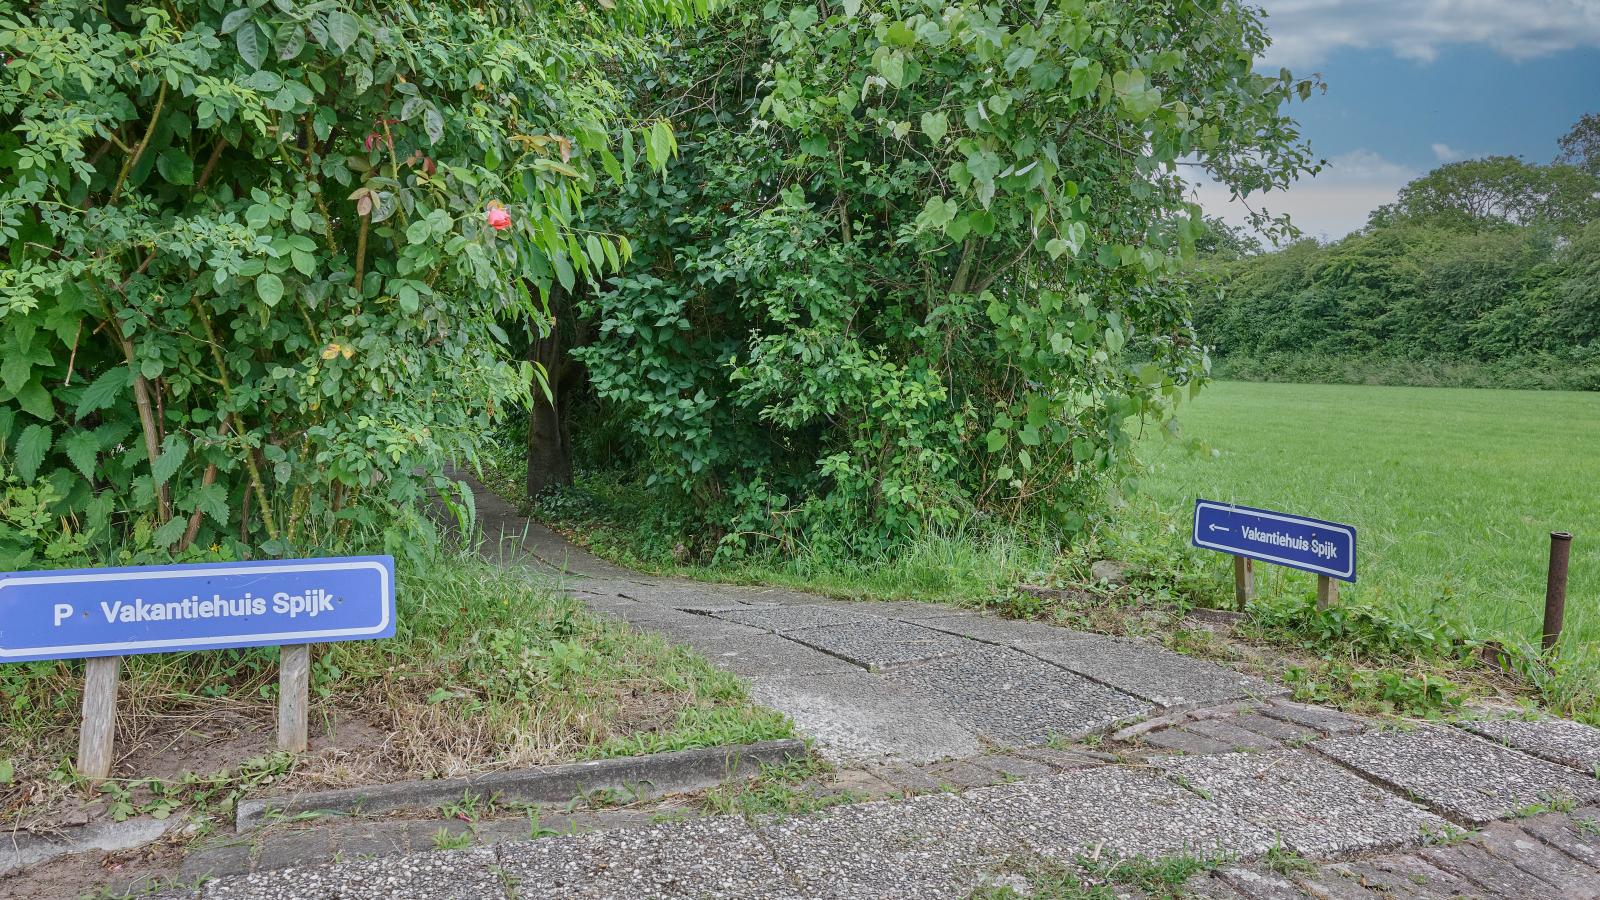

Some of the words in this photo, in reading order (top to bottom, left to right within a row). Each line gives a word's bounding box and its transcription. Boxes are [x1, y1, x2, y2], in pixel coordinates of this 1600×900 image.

[1241, 526, 1309, 551] Vakantiehuis
[1310, 539, 1338, 560] Spijk
[54, 604, 74, 626] P
[100, 593, 267, 623] Vakantiehuis
[273, 589, 335, 617] Spijk
